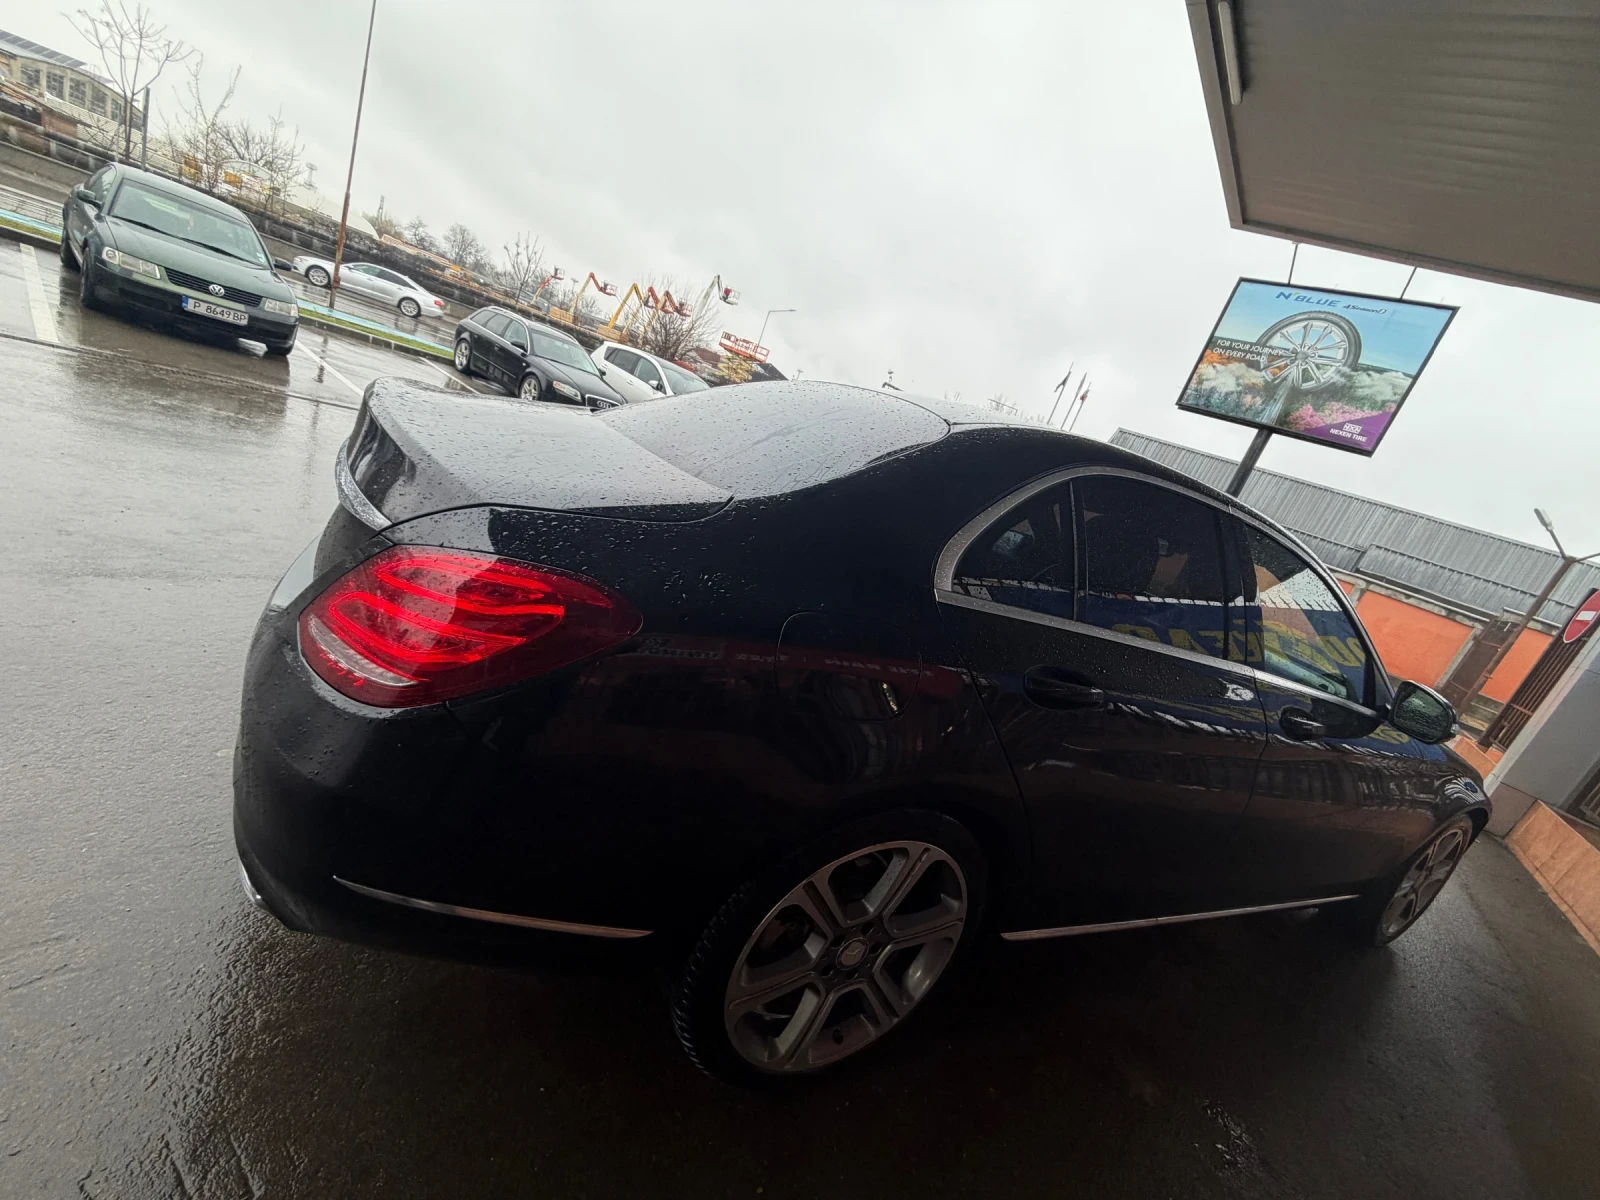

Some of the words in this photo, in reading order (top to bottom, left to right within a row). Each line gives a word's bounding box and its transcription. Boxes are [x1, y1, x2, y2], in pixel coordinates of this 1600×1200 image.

[205, 305, 231, 318] 8649
[233, 313, 246, 322] BP
[1226, 349, 1246, 359] EVERY
[1246, 353, 1266, 362] ROAD
[1232, 342, 1250, 351] YOUR
[1250, 345, 1284, 357] JOURNEY
[1330, 428, 1352, 438] NEXEN
[1352, 434, 1368, 442] TIRE
